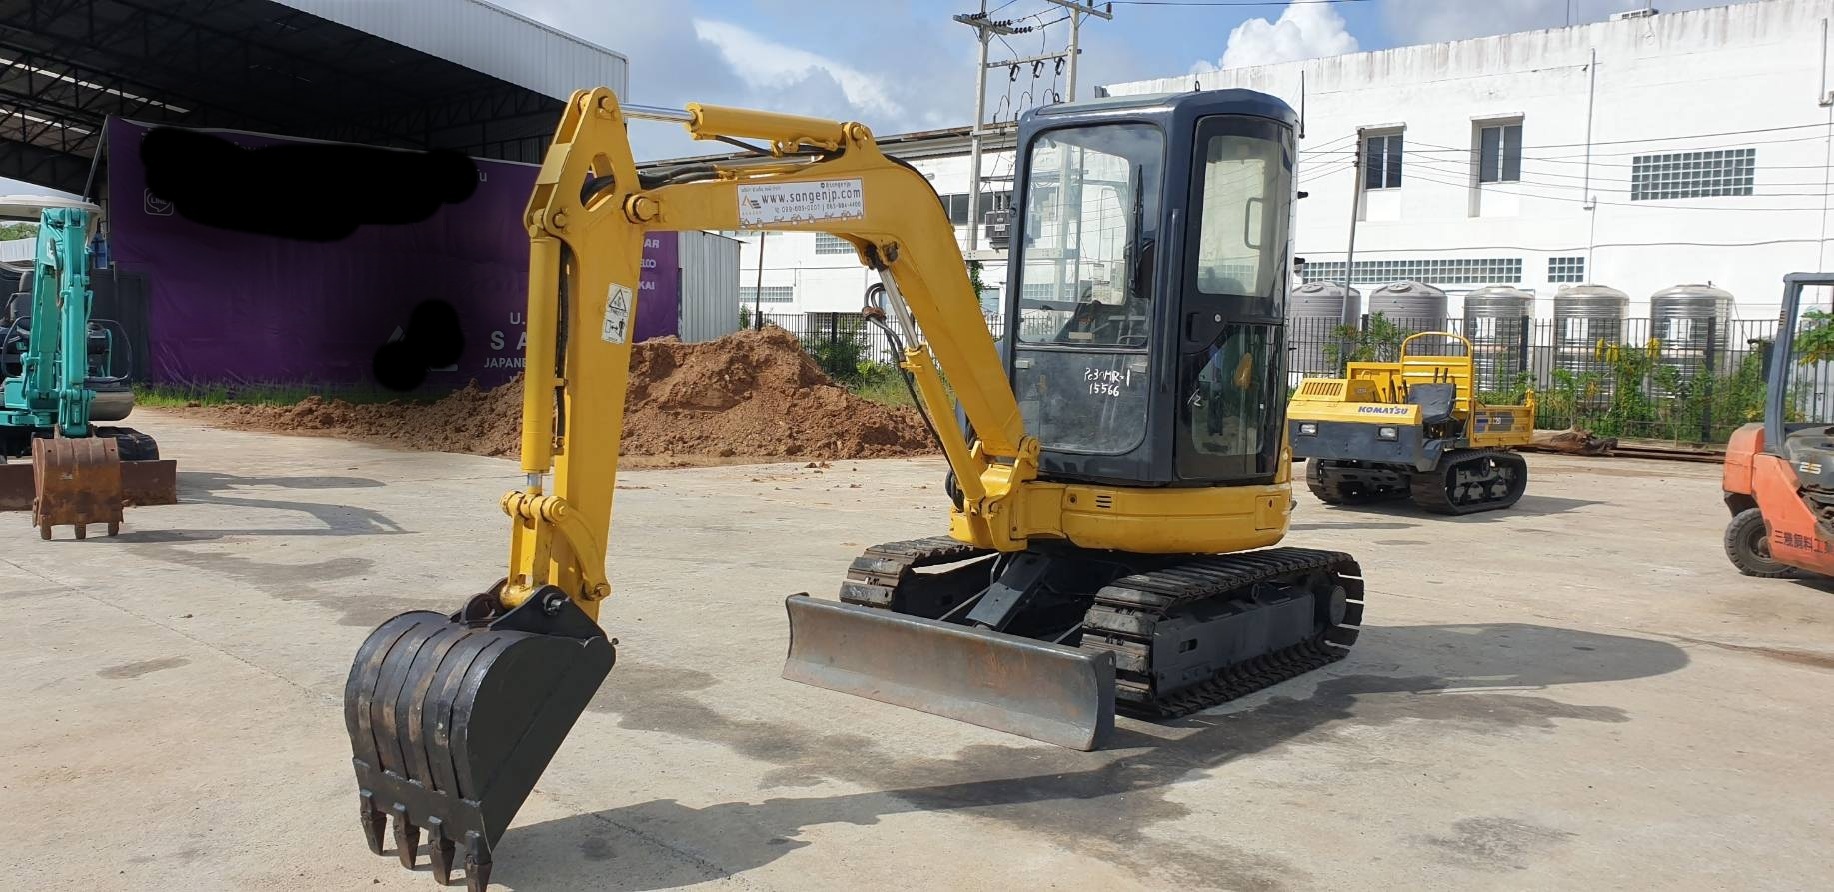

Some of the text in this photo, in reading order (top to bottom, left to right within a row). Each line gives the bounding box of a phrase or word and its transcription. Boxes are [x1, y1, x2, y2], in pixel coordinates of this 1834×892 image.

[762, 188, 861, 204] www.sangenjp.com
[1089, 383, 1119, 397] 15566
[1358, 405, 1408, 415] KOMATSU
